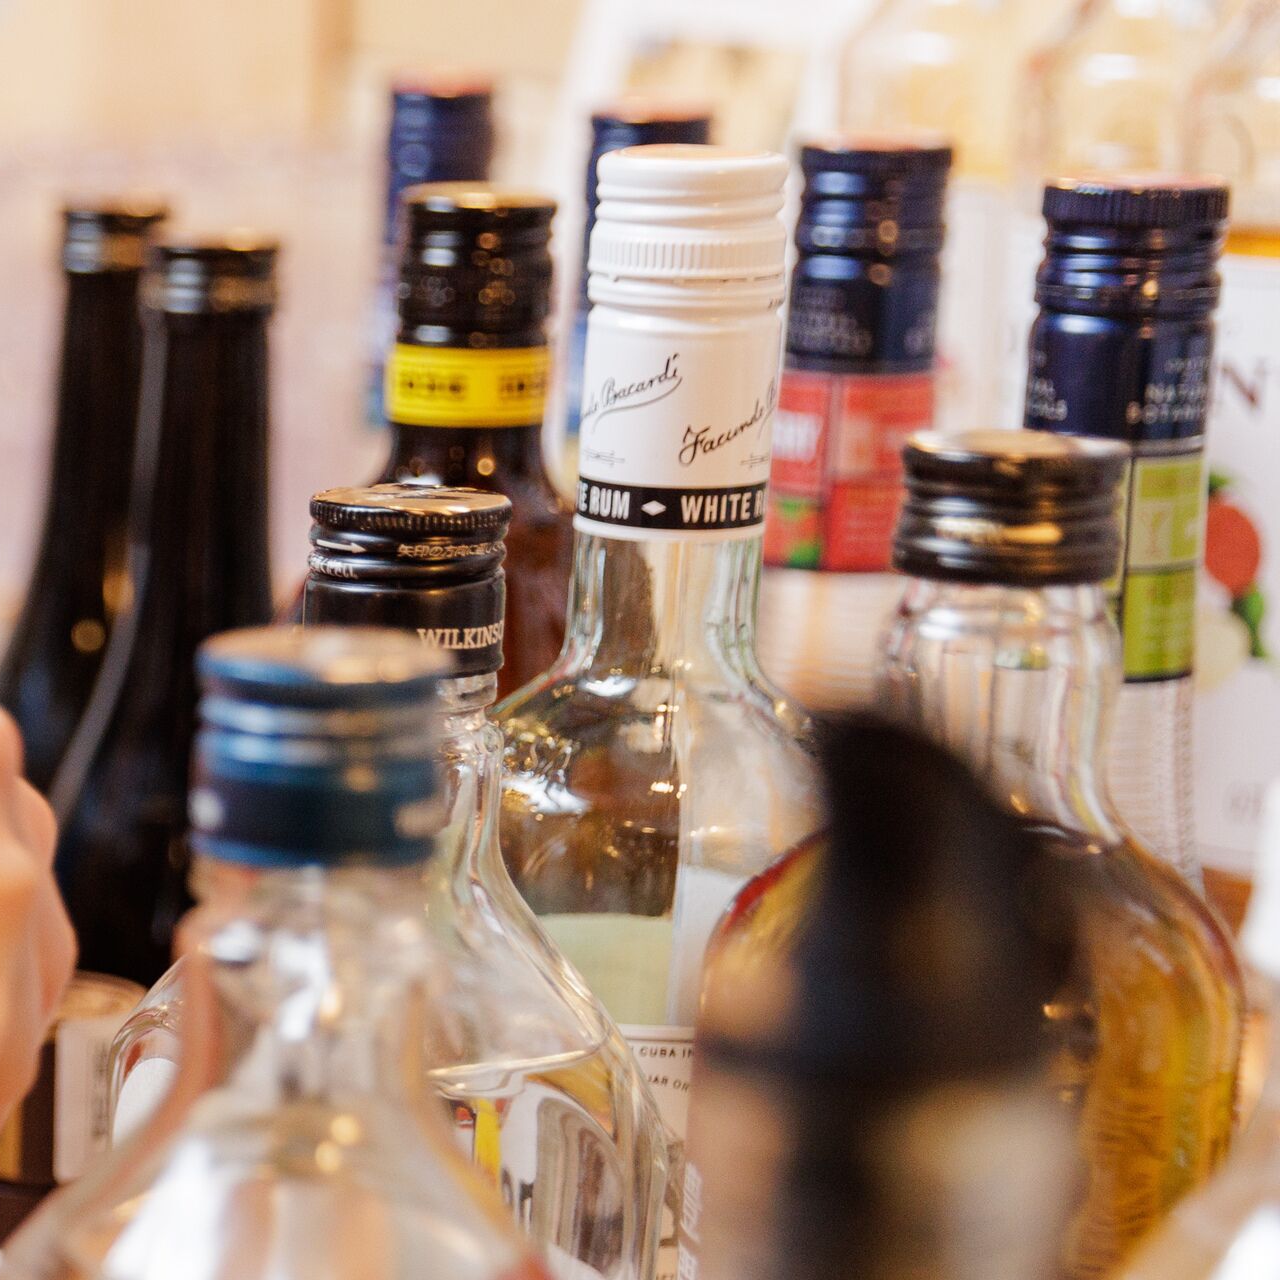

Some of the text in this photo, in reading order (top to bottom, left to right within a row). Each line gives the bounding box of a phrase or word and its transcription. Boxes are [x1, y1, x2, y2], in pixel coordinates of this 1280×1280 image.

[589, 486, 630, 520] RUM
[680, 490, 751, 524] WHITE
[639, 1046, 677, 1058] CUBA
